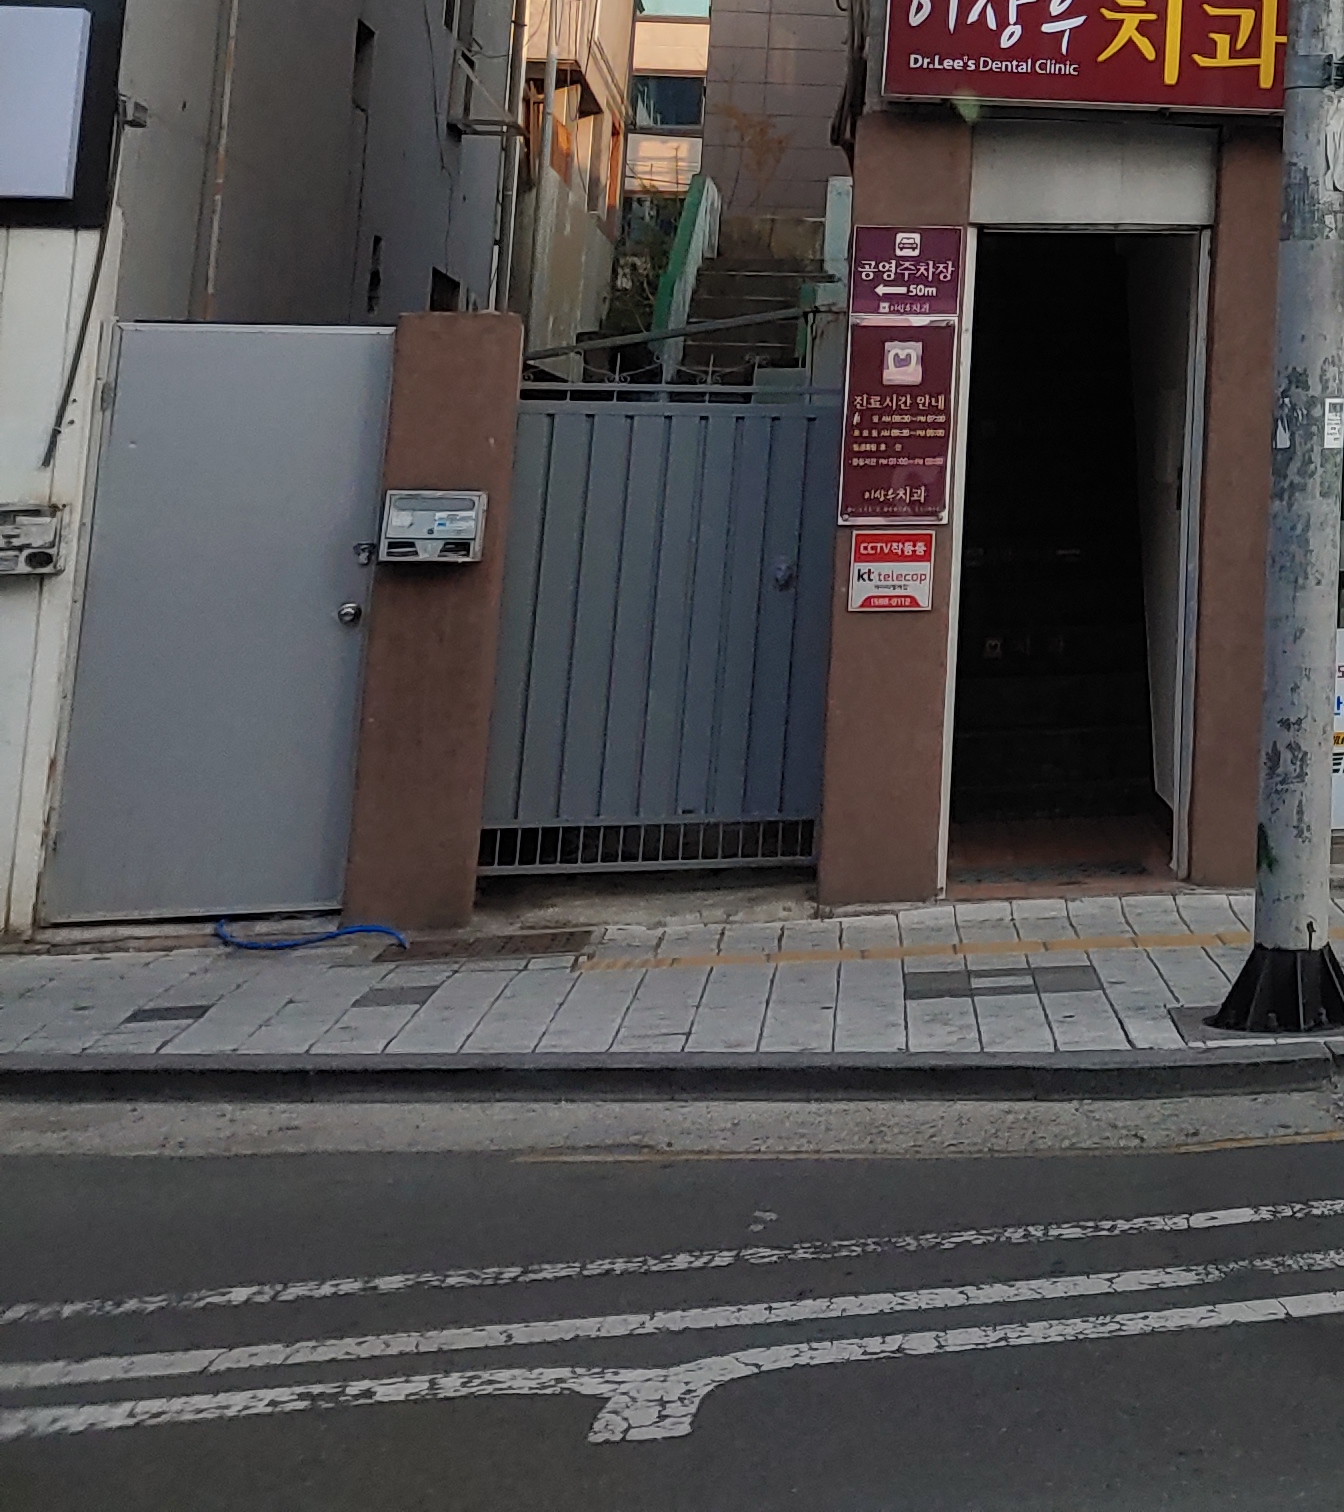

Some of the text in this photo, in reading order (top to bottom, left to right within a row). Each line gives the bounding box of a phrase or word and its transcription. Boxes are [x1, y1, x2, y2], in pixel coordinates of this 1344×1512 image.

[909, 54, 1080, 76] Dr.Lee's Dental Clinic
[857, 259, 956, 282] 공영주차장
[908, 284, 937, 297] 50m
[853, 393, 945, 411] 진료시간 안내
[856, 568, 927, 585] kt telecop
